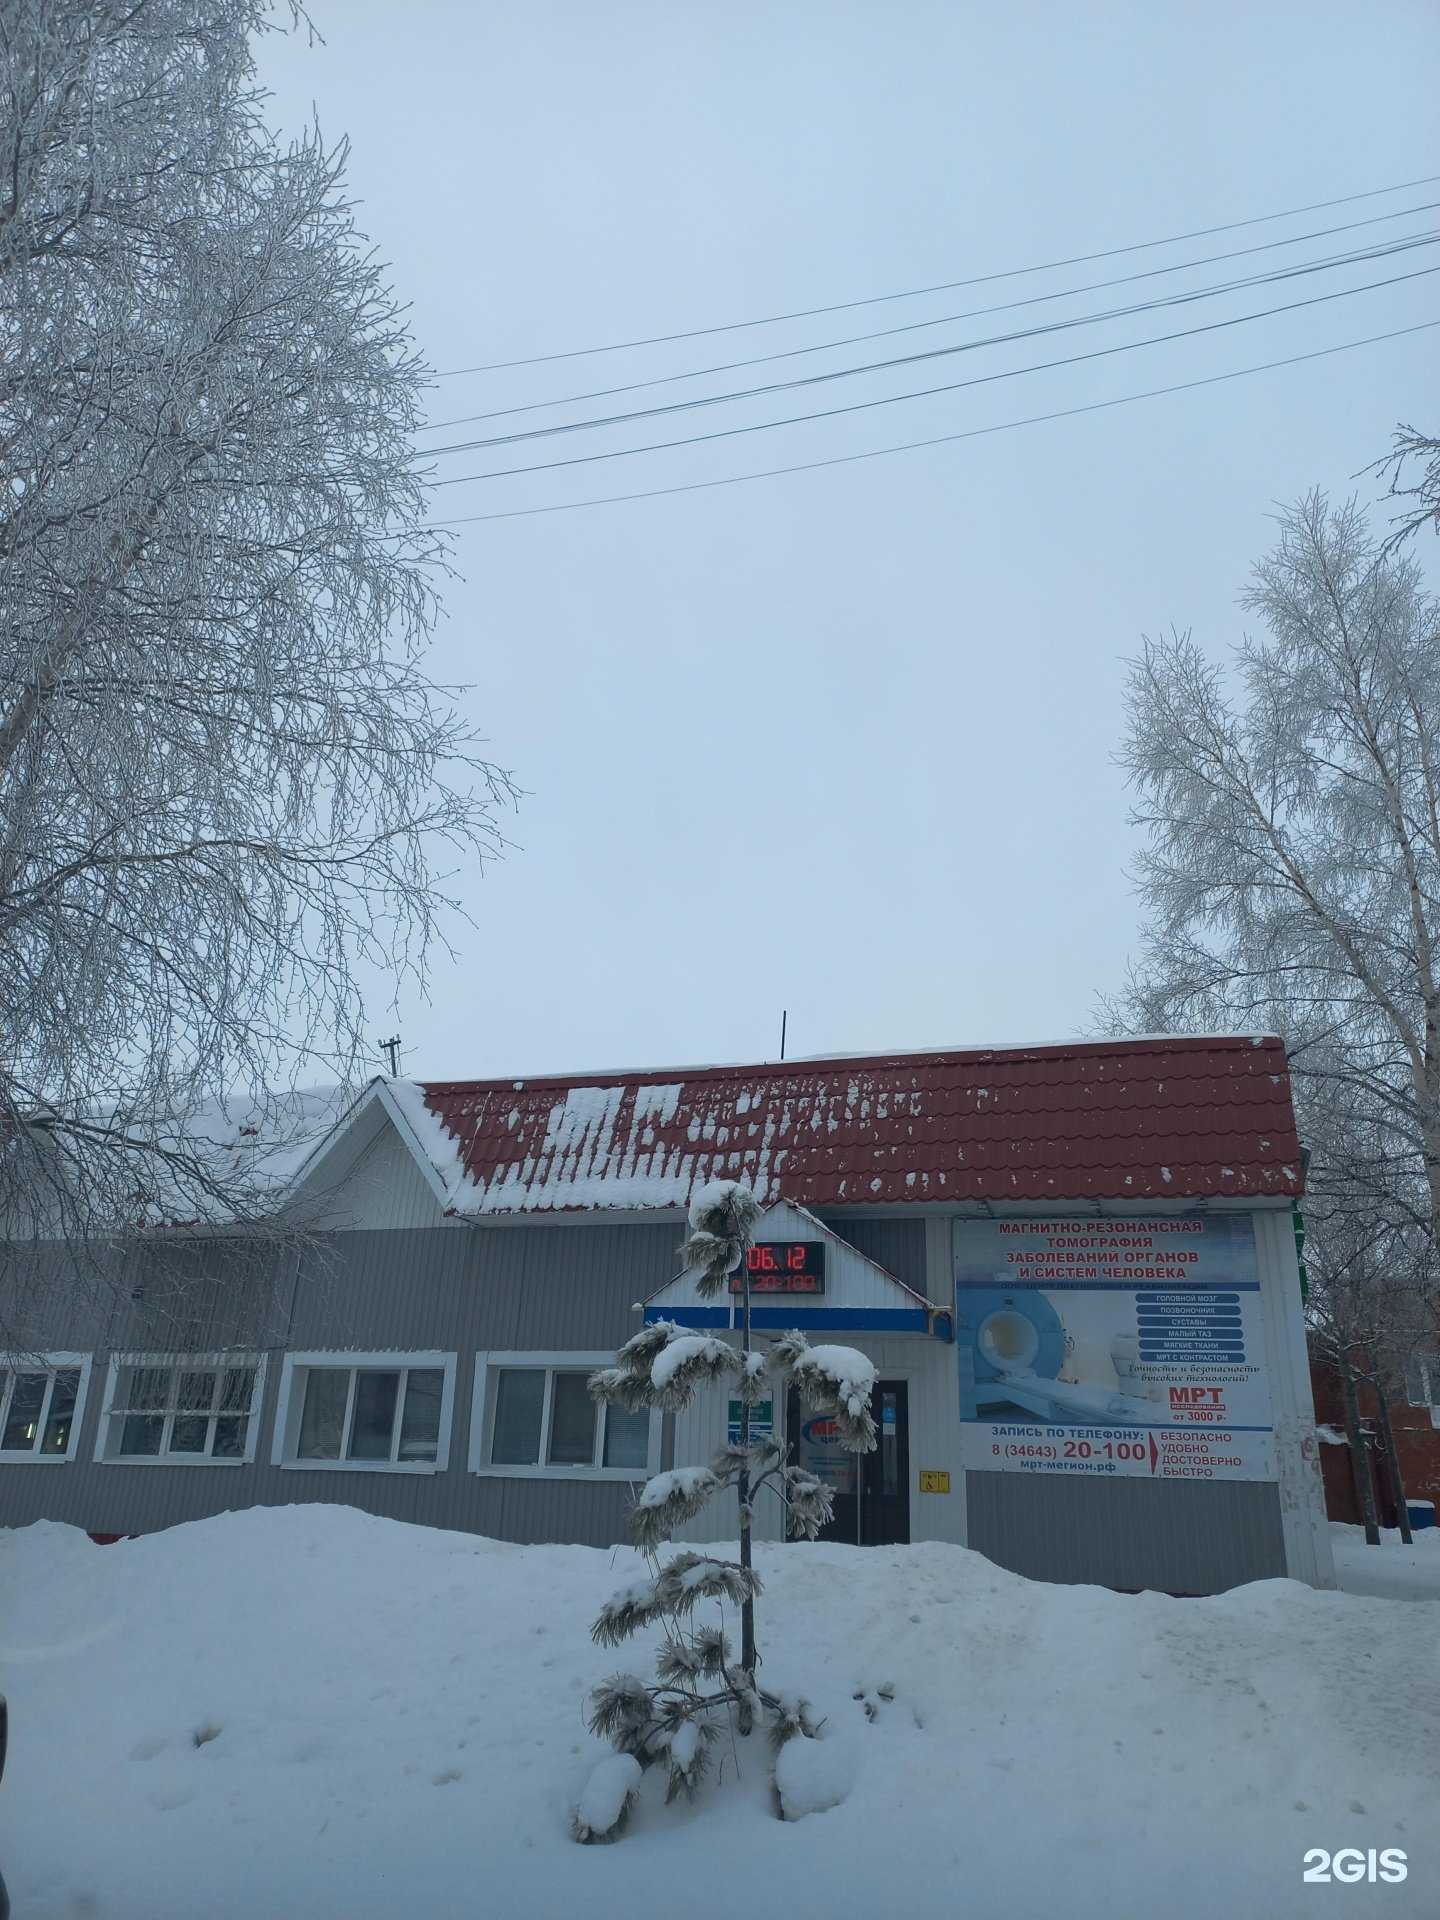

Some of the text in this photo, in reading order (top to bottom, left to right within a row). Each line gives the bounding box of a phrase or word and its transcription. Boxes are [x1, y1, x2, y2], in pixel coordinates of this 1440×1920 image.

[1000, 1222, 1203, 1234] МАГНИТНО-РЕЗОНАНСНАЯ
[1047, 1237, 1153, 1248] ТОМОГРАФИЯ
[1007, 1250, 1199, 1263] ЗАБОЛЕВАНИЙ ОРГАНОВ
[1020, 1267, 1187, 1279] И СИСТЕМ ЧЕЛОВЕКА
[1156, 1294, 1196, 1302] ГОЛОВНОЙ
[1171, 1318, 1207, 1326] СУСТАВЫ
[1168, 1330, 1197, 1338] МАЛЫЙ
[1163, 1341, 1192, 1349] МЯГКИЕ
[1168, 1387, 1224, 1404] МРТ
[1187, 1411, 1214, 1422] 3000
[992, 1426, 1144, 1441] ЗАПИСЬ ПО ТЕЛЕФОНУ:
[1161, 1432, 1232, 1442] БЕЗОПАСНО
[992, 1441, 1146, 1461] 8 (34643) 20-100
[1161, 1443, 1209, 1454] УДОБНО
[1163, 1455, 1242, 1466] ДОСТОВЕРНО
[1020, 1460, 1117, 1474] мрт-мегион.рф
[1164, 1467, 1213, 1477] БЫСТРО
